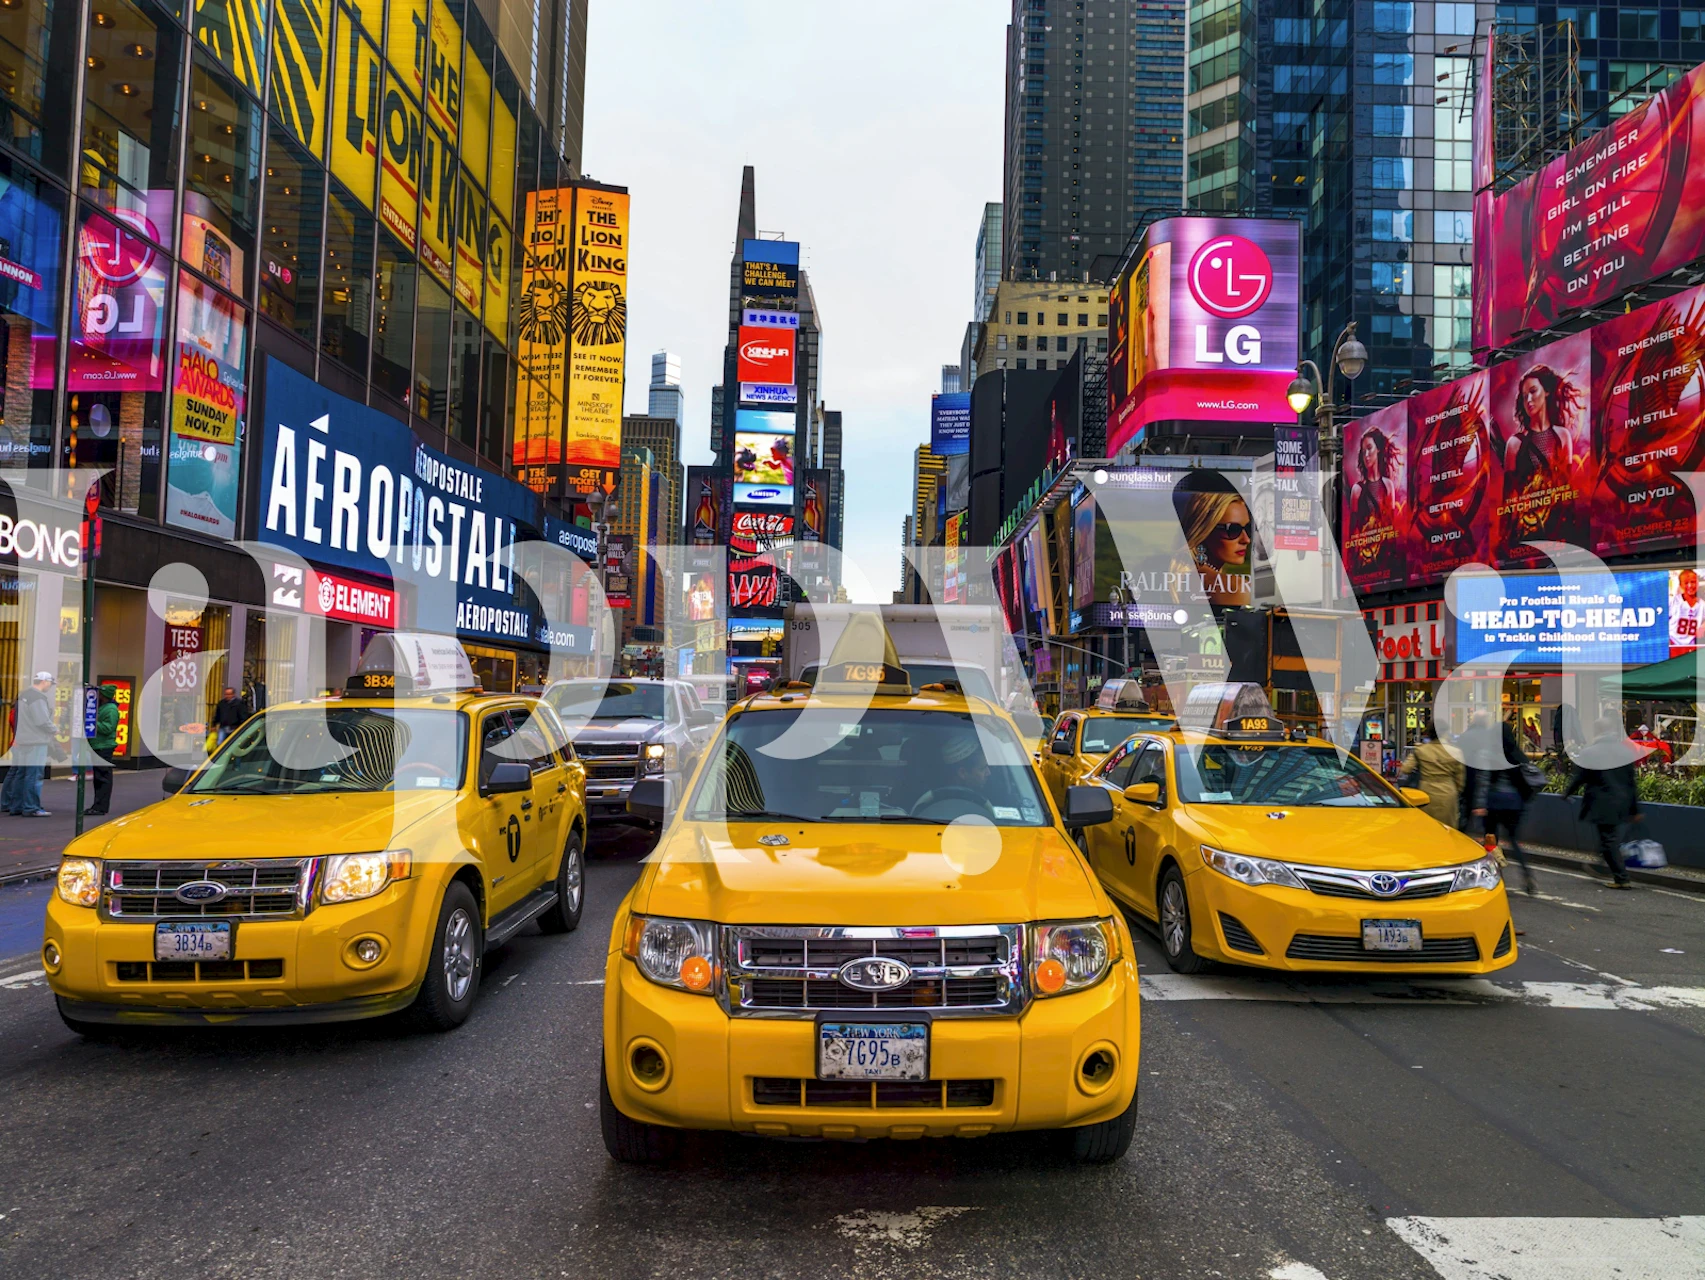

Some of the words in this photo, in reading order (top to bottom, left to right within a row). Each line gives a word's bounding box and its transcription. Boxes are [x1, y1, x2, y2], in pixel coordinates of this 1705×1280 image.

[412, 8, 459, 123] THE
[1556, 128, 1638, 189] REMEMBER
[1548, 197, 1580, 221] GIRL
[1585, 178, 1606, 199] ON
[1612, 153, 1648, 184] FIRE
[382, 201, 416, 244] ENTRANCE
[587, 210, 616, 225] THE
[1562, 222, 1582, 240] I'M
[1587, 196, 1631, 226] STILL
[582, 225, 621, 245] LION
[423, 244, 434, 262] ON
[1563, 224, 1629, 267] BETTING
[578, 248, 625, 271] KING
[745, 262, 771, 271] THAT'S
[744, 270, 787, 280] CHALLENGE
[745, 278, 757, 286] WE
[758, 279, 775, 287] CAN
[776, 281, 796, 289] MEET
[1567, 275, 1588, 293] ON
[1593, 256, 1625, 280] YOU
[1195, 325, 1262, 364] LG
[1617, 326, 1685, 357] REMEMBER
[747, 346, 789, 358] XINHUA
[180, 342, 218, 381] HALO
[575, 364, 619, 375] REMEMBER
[573, 373, 582, 381] IT
[583, 375, 622, 384] FOREVER.
[1612, 381, 1640, 396] GIRL
[1642, 375, 1660, 387] ON
[1662, 363, 1690, 384] FIRE
[177, 366, 236, 410] AWARDS
[754, 386, 788, 395] XINHUA
[746, 394, 767, 402] NEWS
[1197, 400, 1259, 410] www.LG.com
[186, 398, 228, 424] SUNDAY
[1425, 404, 1469, 425] REMEMBER
[1624, 416, 1640, 430] I'M
[1643, 408, 1678, 426] STILL
[185, 415, 209, 434] NOV.
[211, 426, 222, 438] 17
[1276, 440, 1303, 454] SOME
[1421, 443, 1438, 456] GIRL
[1440, 439, 1452, 450] ON
[1453, 434, 1473, 448] FIRE
[1276, 453, 1306, 467] WALLS
[1624, 445, 1678, 467] BETTING
[415, 442, 483, 504] AÉROPOSTALE
[580, 468, 601, 478] GET
[1110, 471, 1153, 488] sunglass
[1154, 473, 1172, 484] hut
[1276, 466, 1296, 479] CAN
[1430, 474, 1441, 483] I'M
[1442, 468, 1463, 481] STILL
[1277, 479, 1299, 492] TALK
[1628, 491, 1646, 504] ON
[1649, 485, 1675, 500] YOU
[1496, 496, 1551, 515] CATCHING
[1554, 489, 1580, 503] FIRE
[1519, 490, 1545, 502] HUNGER
[1429, 499, 1464, 514] BETTING
[1616, 521, 1672, 536] NOVEMBER
[1674, 518, 1689, 527] 22
[1345, 535, 1381, 549] CATCHING
[1382, 531, 1400, 540] FIRE
[1431, 535, 1443, 544] ON
[1444, 531, 1461, 541] YOU
[607, 543, 624, 551] SOME
[1120, 570, 1191, 593] RALPH
[1200, 572, 1252, 594] LAUR
[336, 583, 391, 620] ELEMENT
[1499, 596, 1517, 607] Pro
[1521, 595, 1566, 606] Football
[1568, 595, 1605, 605] Rivals
[1608, 594, 1624, 605] Go
[456, 597, 529, 639] AÉROPOSTALE
[791, 621, 811, 631] 505
[1677, 616, 1698, 637] 88
[171, 628, 199, 649] TEES
[1484, 633, 1496, 642] to
[1498, 632, 1536, 642] Tackle
[1539, 632, 1596, 642] Childhood
[1598, 632, 1640, 642] Cancer
[177, 649, 182, 660] 3
[169, 661, 198, 688] $33
[364, 674, 395, 688] 3B34
[844, 664, 886, 682] 7G95
[1240, 718, 1269, 731] 1A93
[847, 1026, 873, 1038] NEW
[874, 1026, 900, 1039] YORK
[846, 1040, 900, 1066] 7G95B
